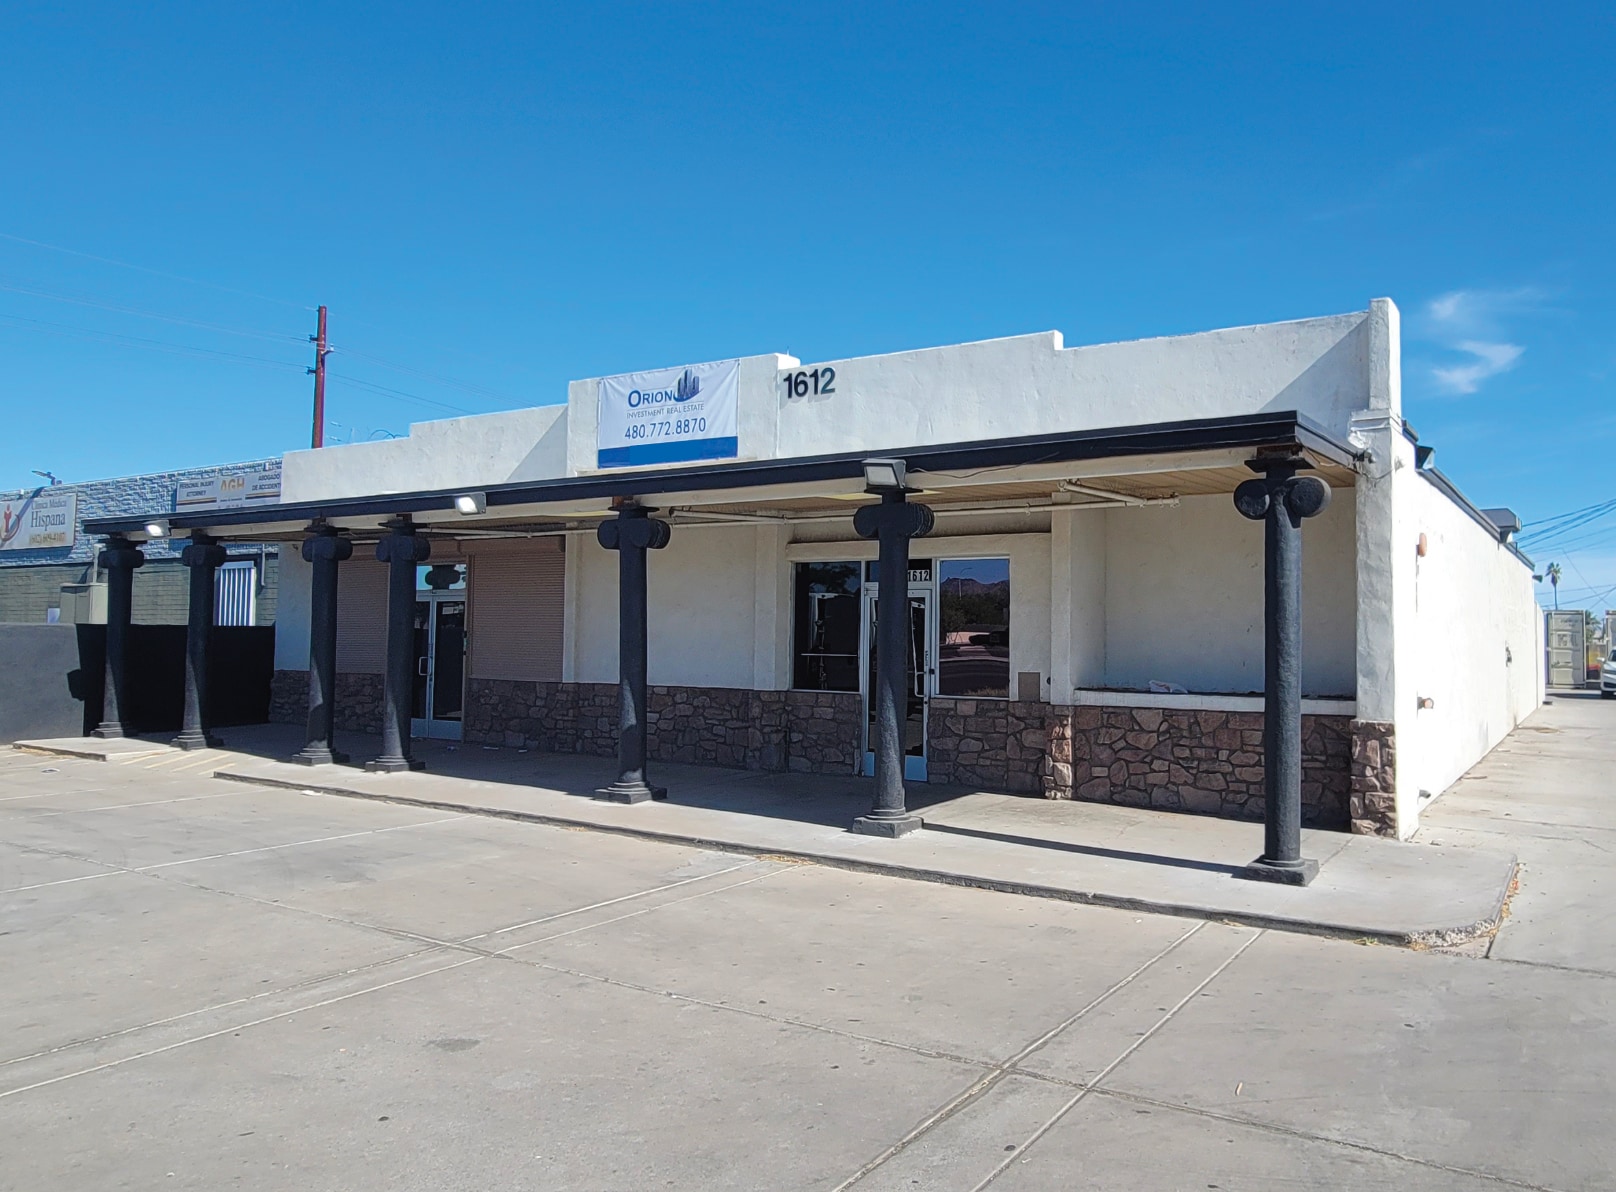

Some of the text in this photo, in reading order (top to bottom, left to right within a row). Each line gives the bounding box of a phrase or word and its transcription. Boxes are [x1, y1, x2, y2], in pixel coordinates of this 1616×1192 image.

[783, 367, 836, 399] 1612
[628, 389, 673, 408] ORION
[627, 403, 704, 419] INVESTMENT REAL ESTATE
[624, 417, 706, 440] 480.772.8870
[179, 480, 214, 490] PERSONAL INJURY
[258, 473, 281, 481] ABOGADO
[186, 490, 207, 498] ATTORNEY
[31, 510, 66, 531] Hispana
[908, 570, 929, 582] 1612
